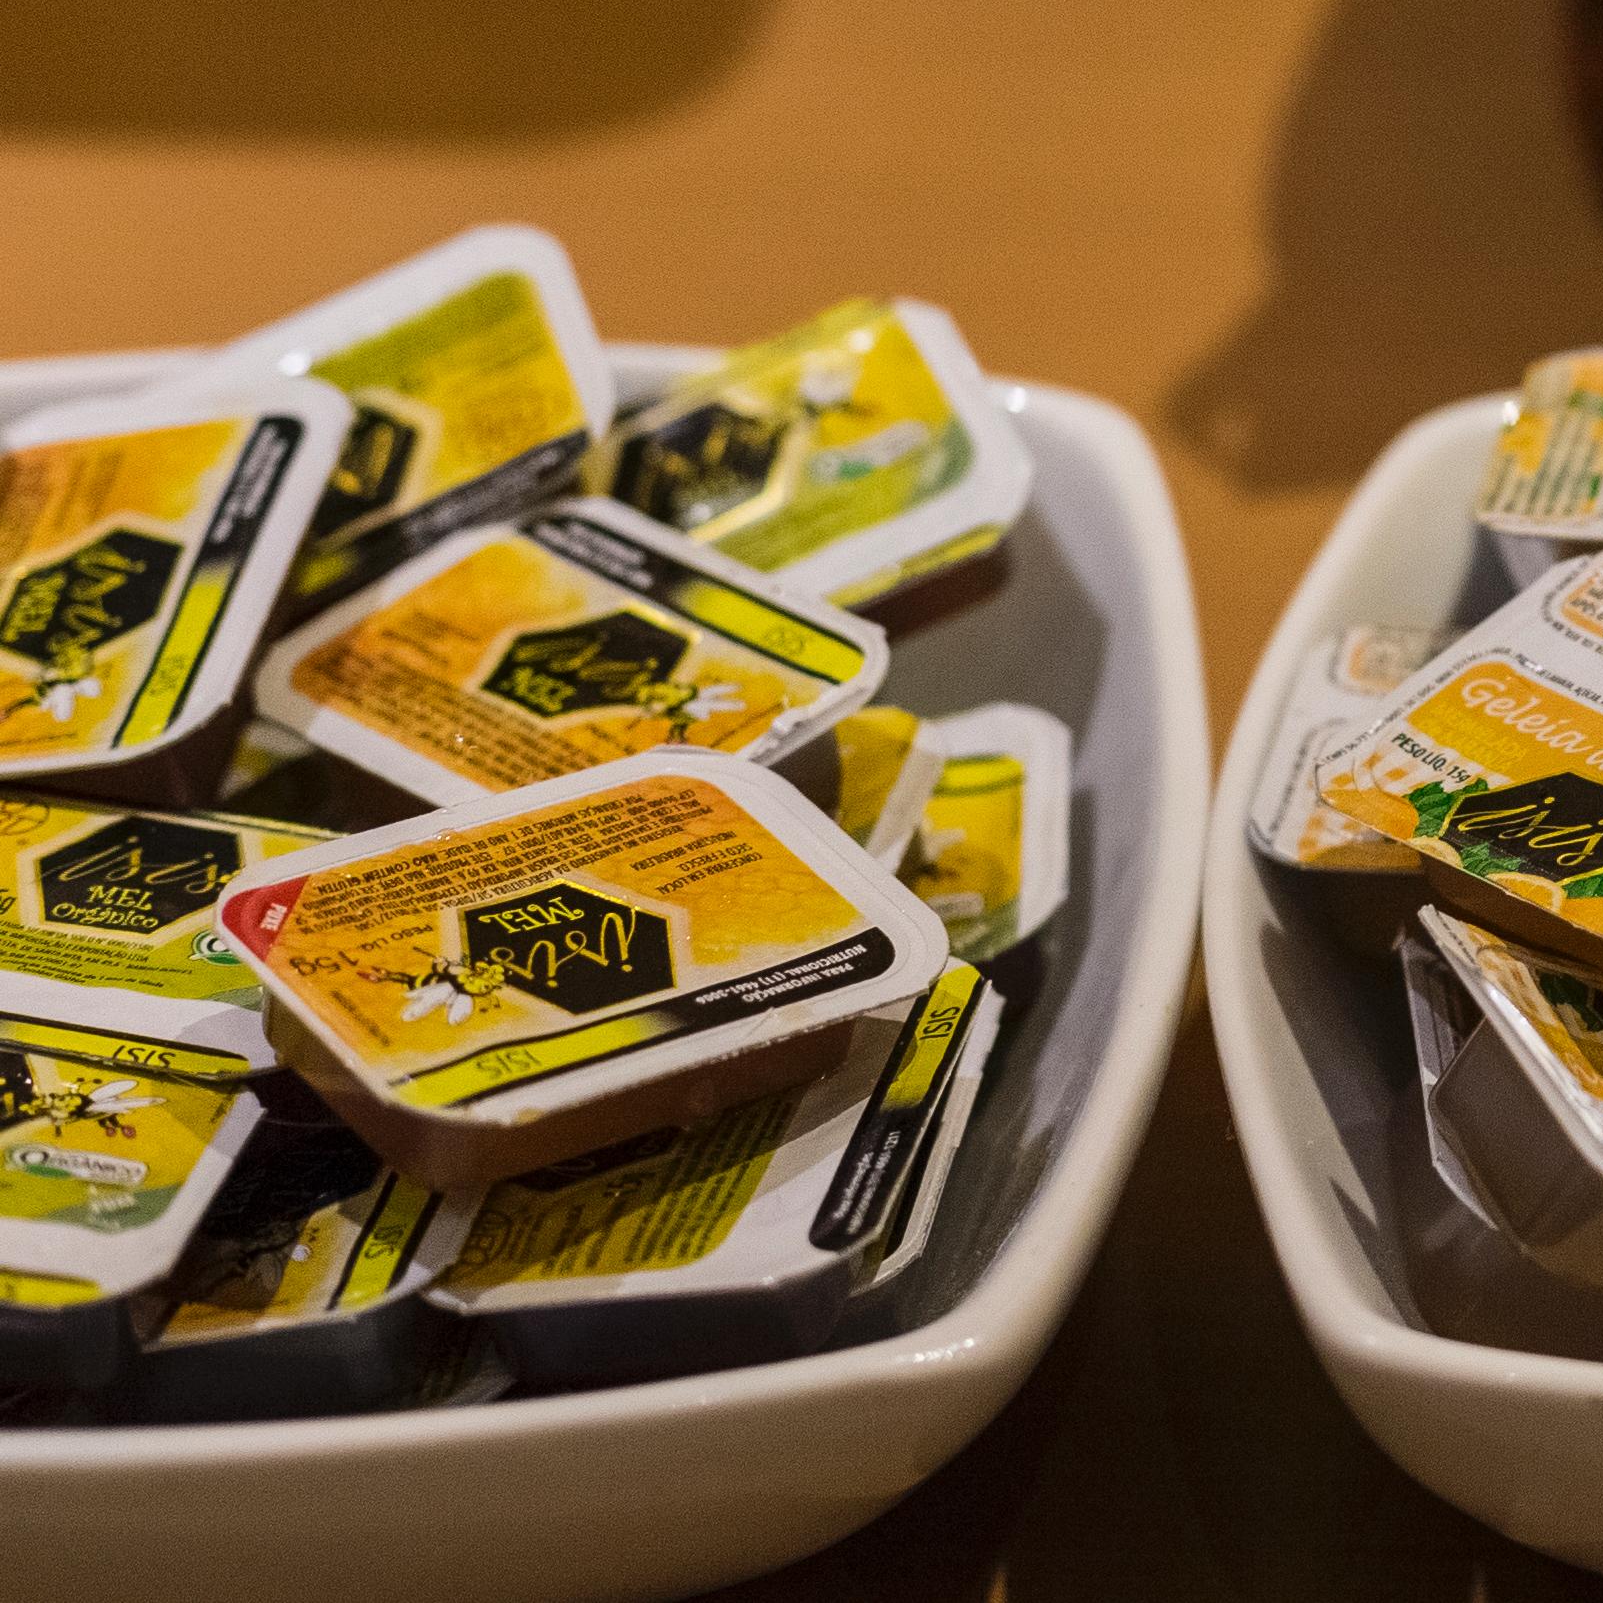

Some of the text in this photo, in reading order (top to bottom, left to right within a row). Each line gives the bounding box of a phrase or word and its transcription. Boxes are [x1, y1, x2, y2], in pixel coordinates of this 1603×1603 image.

[1461, 676, 1596, 753] Geleia
[1385, 731, 1432, 760] PESO
[88, 881, 153, 912] MEL
[478, 895, 587, 936] MEL
[290, 943, 359, 979] 15g
[917, 996, 962, 1052] ISIS
[472, 1046, 544, 1082] ISIS
